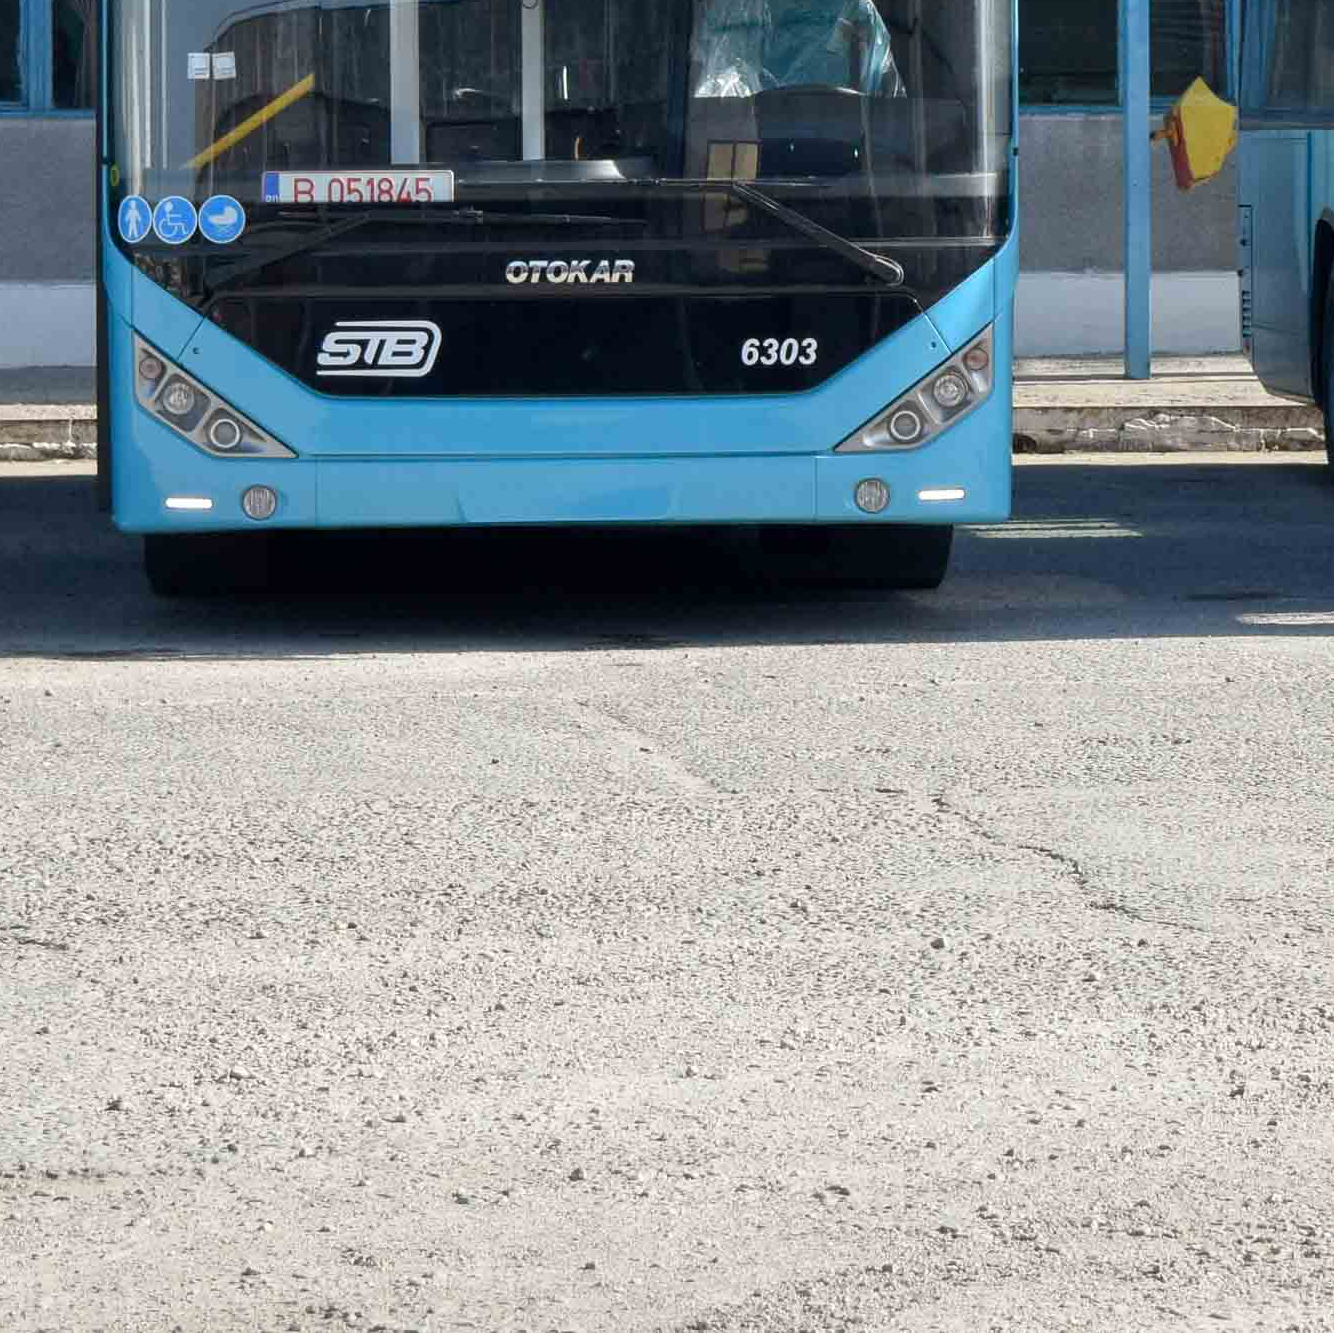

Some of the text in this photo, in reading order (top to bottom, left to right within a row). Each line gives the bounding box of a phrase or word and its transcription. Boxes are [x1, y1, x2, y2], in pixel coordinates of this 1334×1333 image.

[293, 177, 433, 204] B 051845
[504, 259, 636, 284] OTOKAR
[316, 329, 431, 368] STB
[740, 336, 818, 366] 6303
